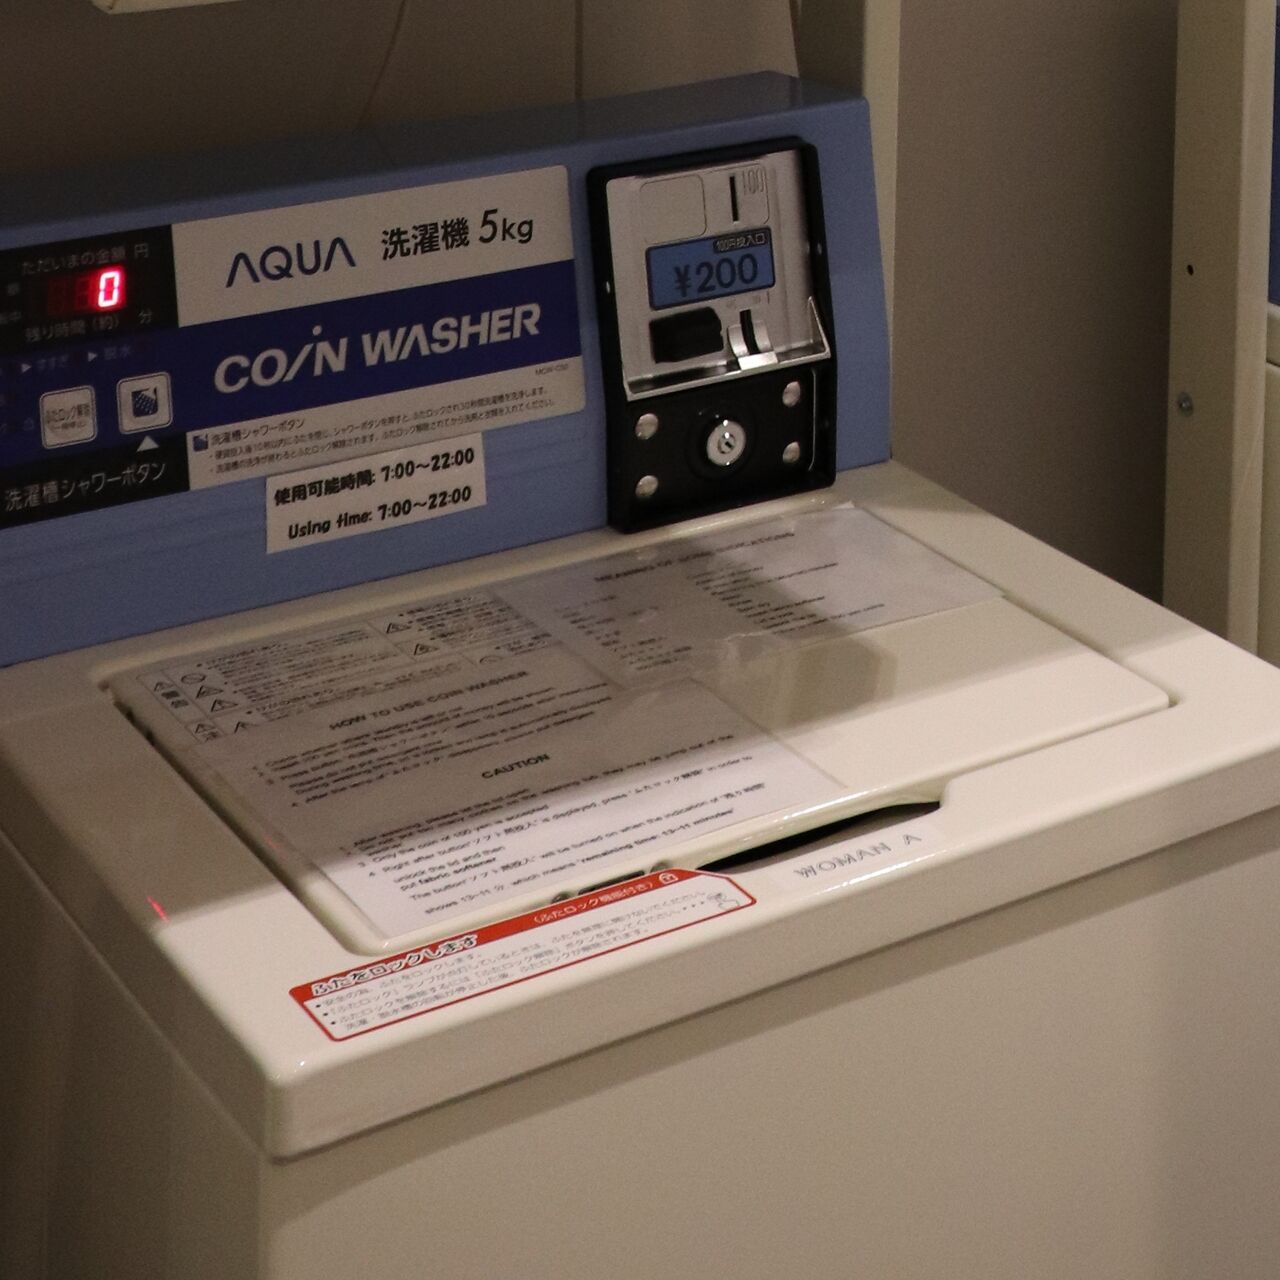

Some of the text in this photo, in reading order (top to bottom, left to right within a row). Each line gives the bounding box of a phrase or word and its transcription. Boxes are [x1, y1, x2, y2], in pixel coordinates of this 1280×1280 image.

[381, 217, 470, 260] 洗濯機
[478, 208, 534, 245] 5kg
[226, 237, 356, 288] AQUA
[673, 253, 759, 298] ¥200
[98, 271, 120, 307] 0
[362, 302, 541, 368] WASHER
[5, 461, 167, 512] 洗濯槽シャワーボタン
[274, 470, 376, 506] 使用可能時間:
[288, 517, 331, 540] Using
[481, 753, 550, 779] CAUTION
[794, 842, 892, 878] WOMAN
[311, 934, 478, 997] ふたをロックします
